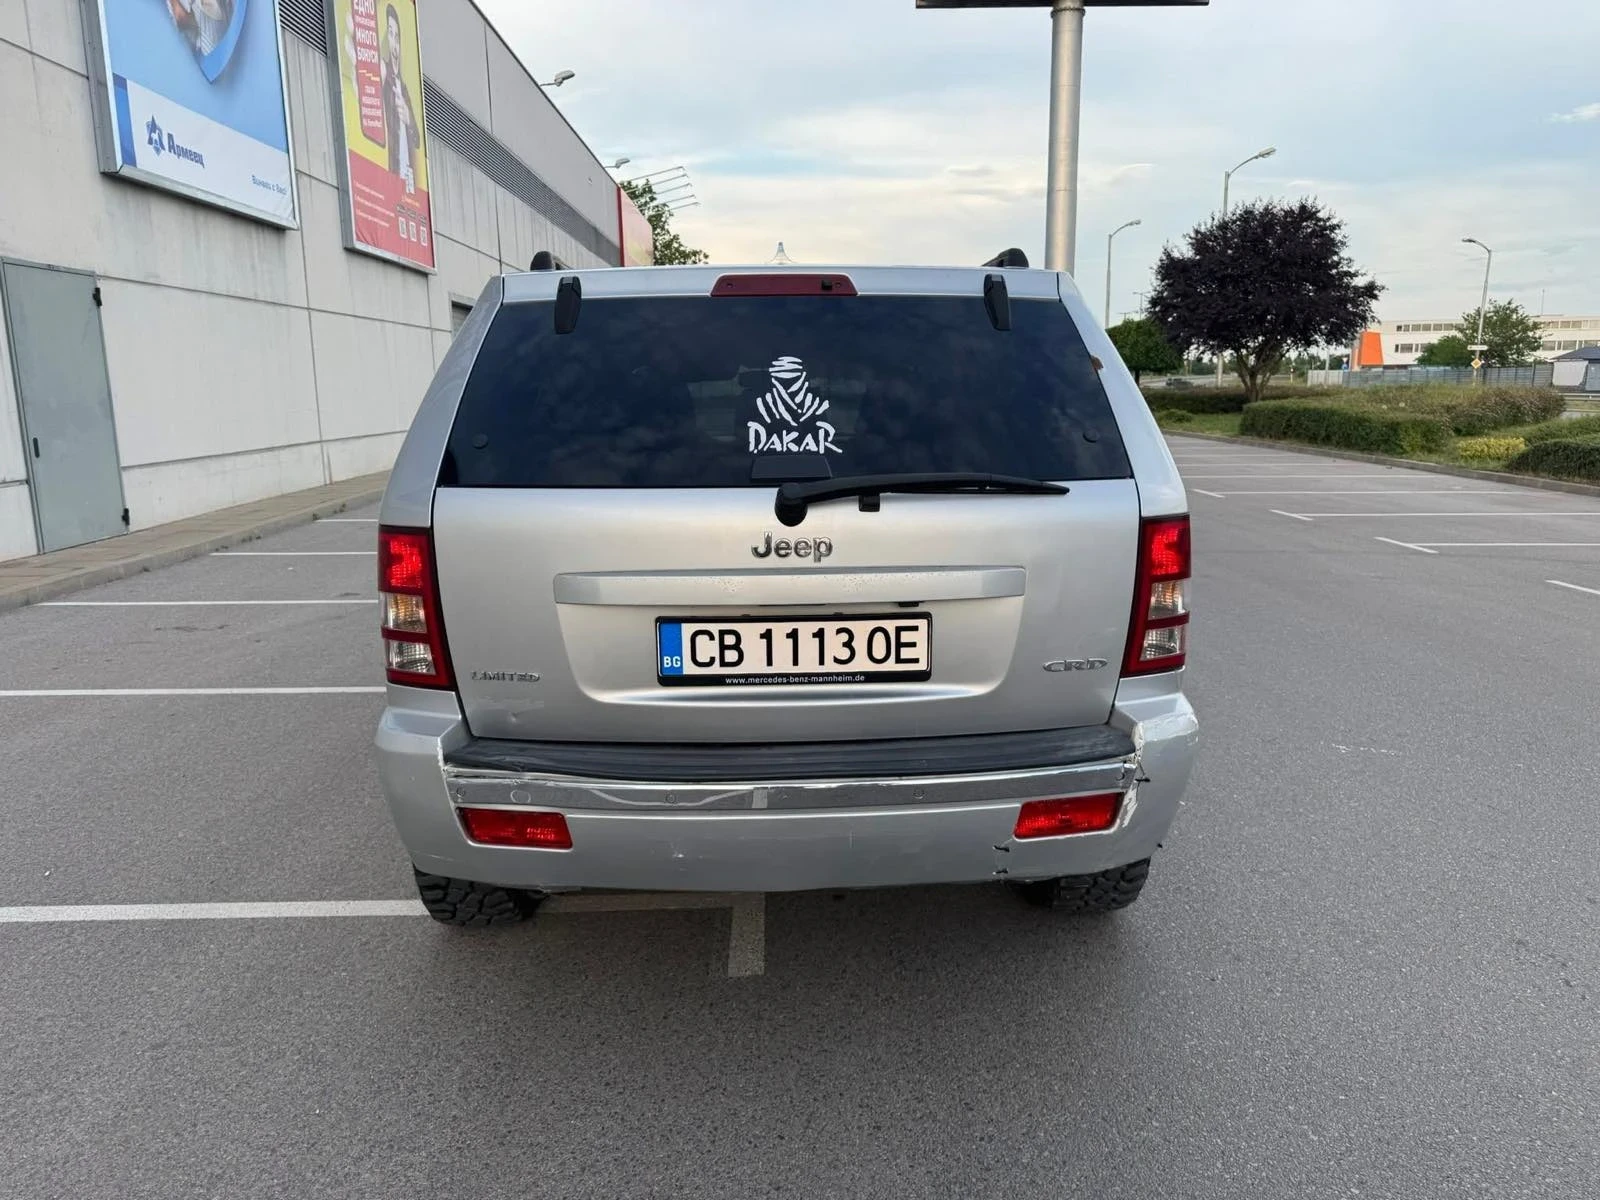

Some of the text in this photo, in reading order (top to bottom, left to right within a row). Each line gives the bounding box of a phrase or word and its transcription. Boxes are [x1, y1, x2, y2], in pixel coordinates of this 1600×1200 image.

[167, 132, 205, 169] Армеец
[747, 421, 843, 454] DAKAR
[751, 531, 833, 563] Jeep
[689, 629, 744, 668] CB
[759, 627, 856, 667] 1113
[663, 656, 681, 668] BG
[1042, 658, 1108, 672] CRD
[471, 671, 541, 682] LIMITED
[725, 674, 865, 685] www.mercedes-benz-mannheim.de
